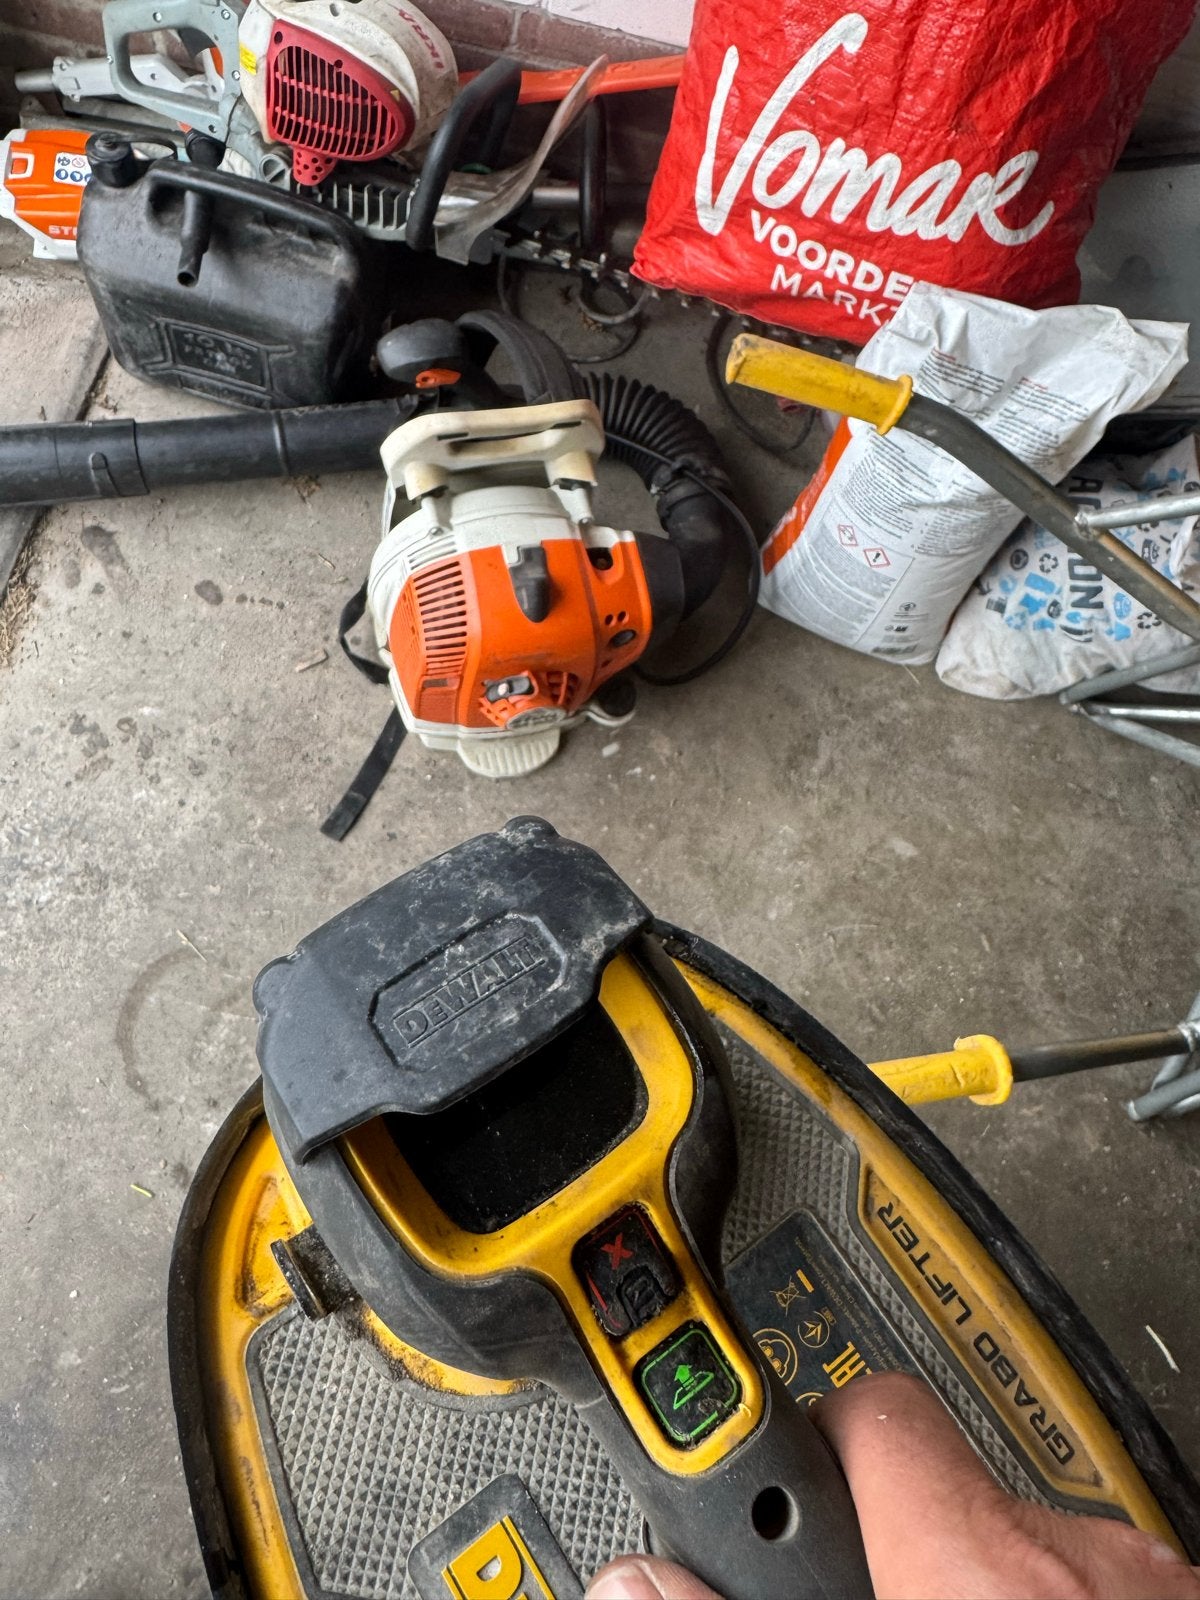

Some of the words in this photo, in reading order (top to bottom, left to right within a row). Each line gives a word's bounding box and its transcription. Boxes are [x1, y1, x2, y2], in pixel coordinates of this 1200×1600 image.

[769, 263, 898, 327] MARK
[393, 940, 537, 1046] DEWALT
[876, 1201, 973, 1327] LIFTER
[972, 1330, 1076, 1466] GRABO
